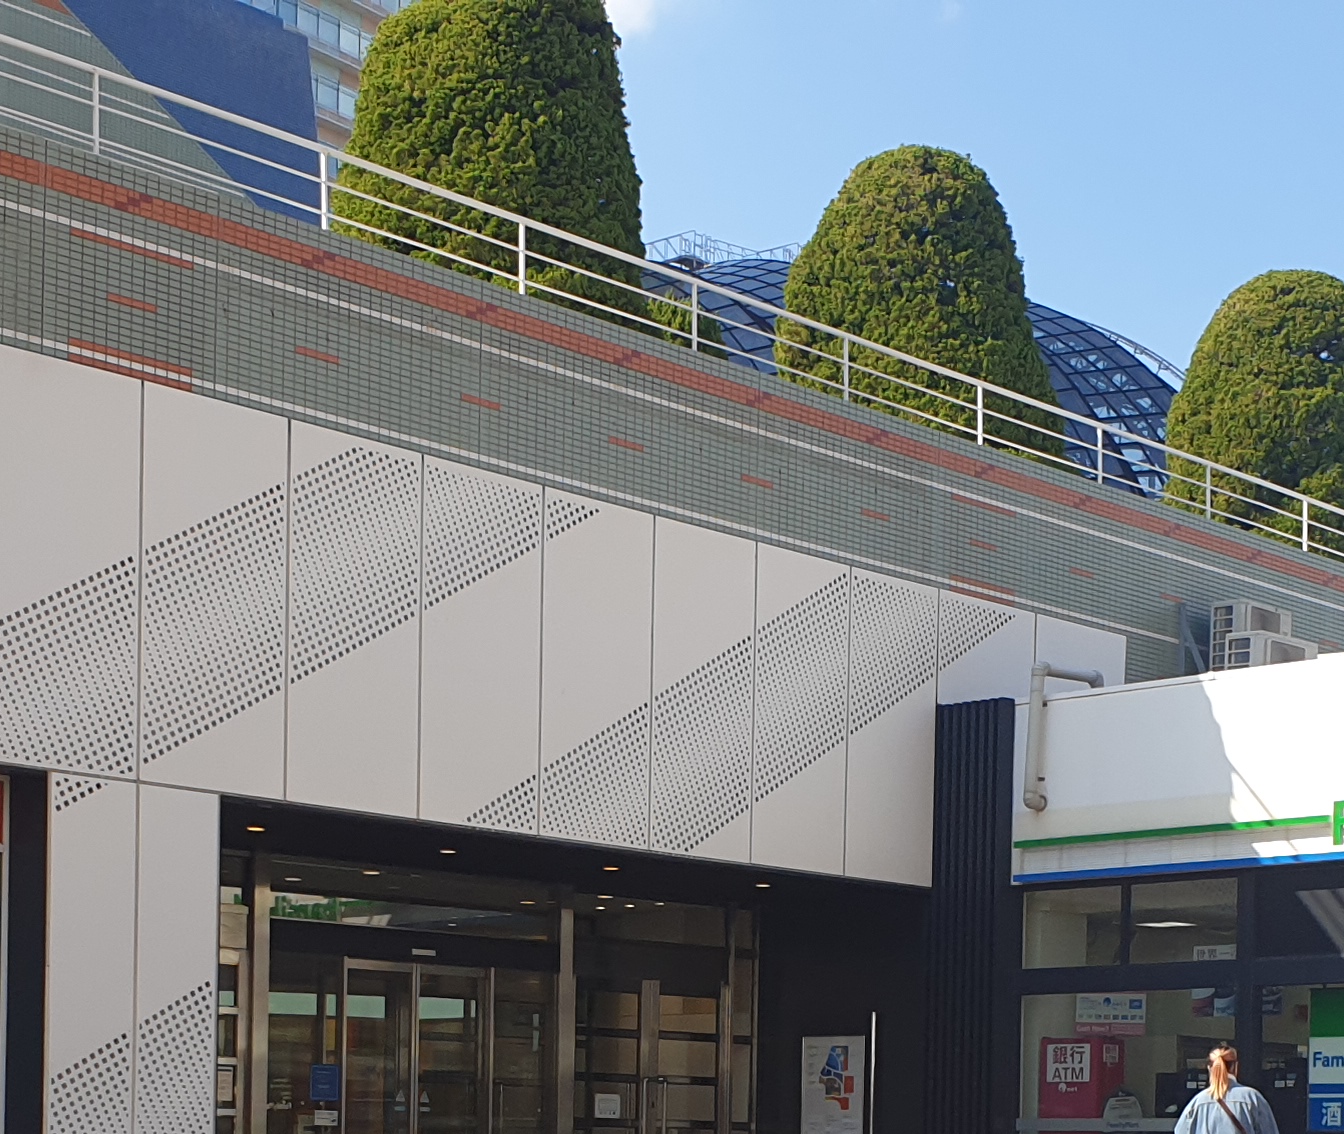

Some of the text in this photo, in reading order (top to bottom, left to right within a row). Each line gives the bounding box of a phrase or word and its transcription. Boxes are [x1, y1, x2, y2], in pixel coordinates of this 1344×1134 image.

[1052, 1045, 1086, 1065] 銀行
[1052, 1067, 1084, 1081] ATM
[1321, 1101, 1342, 1127] 酒
